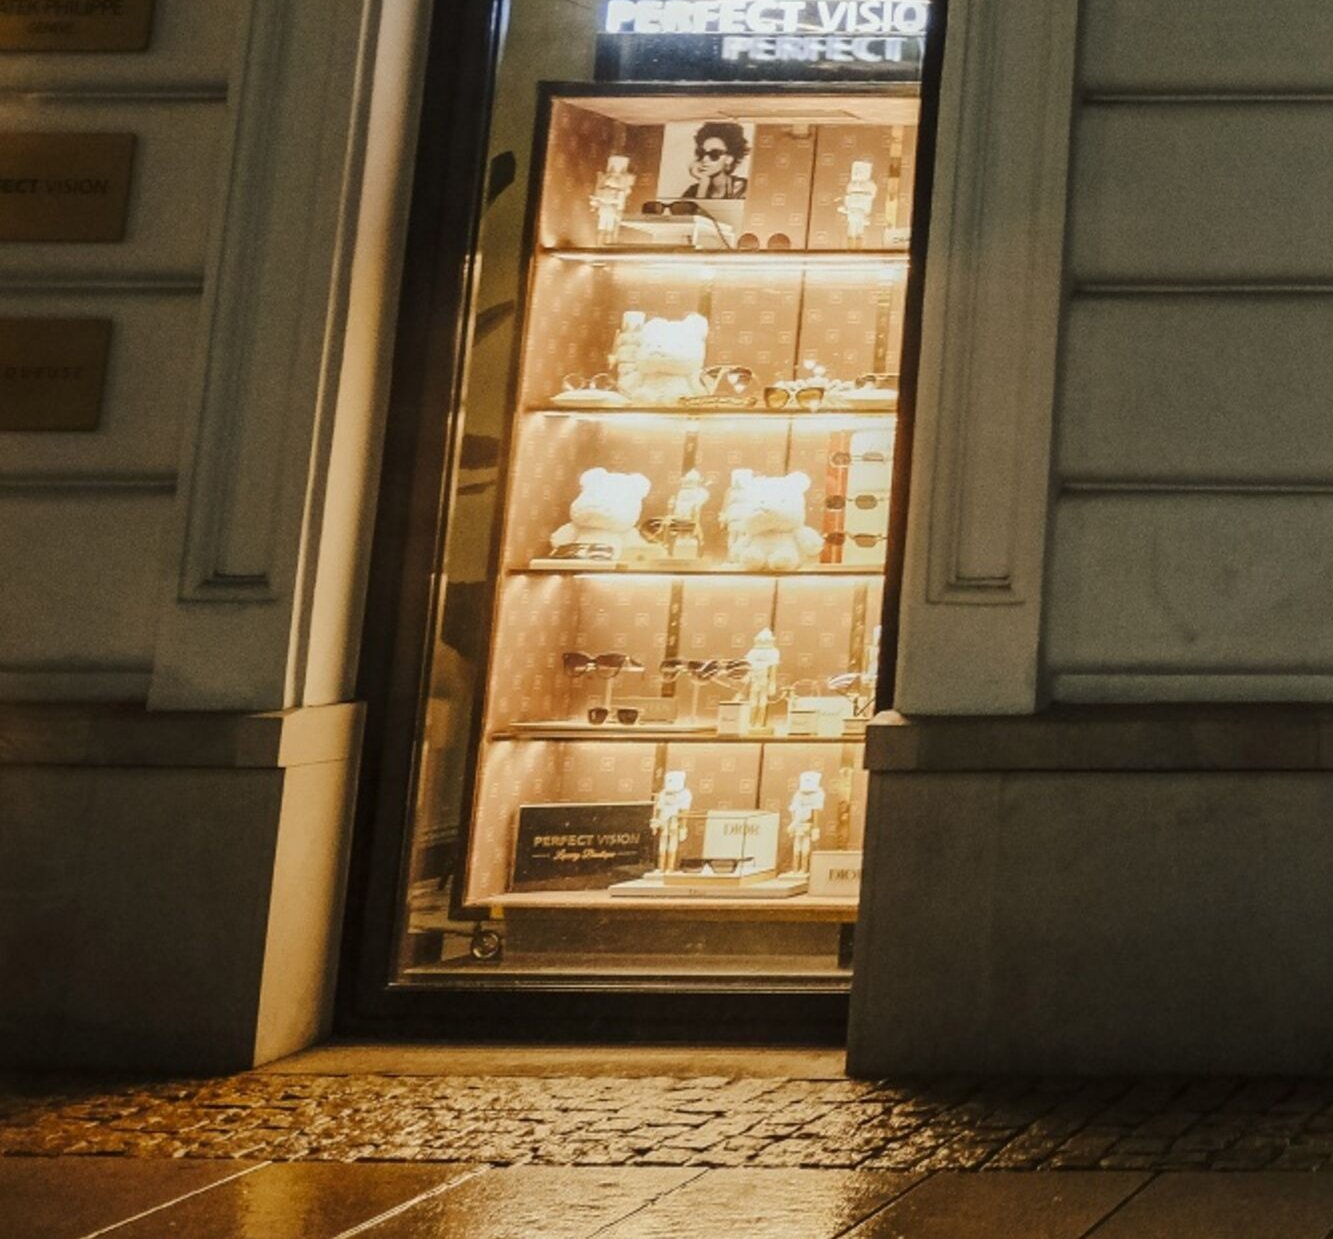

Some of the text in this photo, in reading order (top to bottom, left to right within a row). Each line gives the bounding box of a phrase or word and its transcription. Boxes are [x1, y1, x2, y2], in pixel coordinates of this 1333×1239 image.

[0, 0, 124, 15] ATEK PHILIPPE
[605, 0, 928, 34] PERFECT VISIO
[722, 38, 906, 61] PERFECT
[45, 178, 109, 193] VISION
[534, 833, 640, 846] PERFECT VISION
